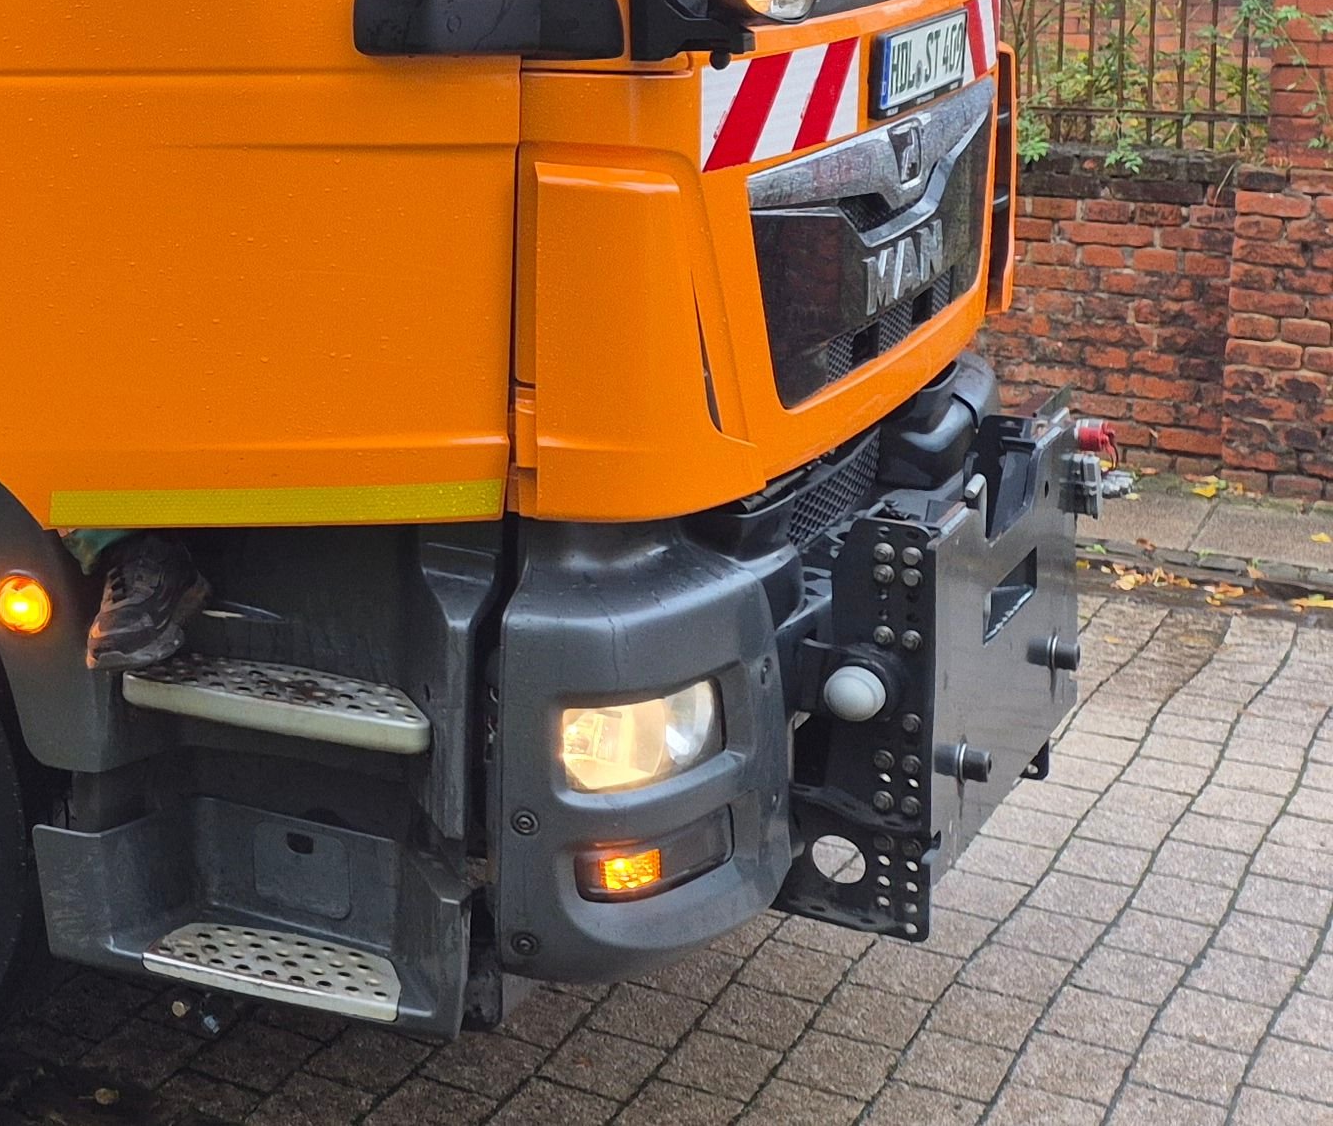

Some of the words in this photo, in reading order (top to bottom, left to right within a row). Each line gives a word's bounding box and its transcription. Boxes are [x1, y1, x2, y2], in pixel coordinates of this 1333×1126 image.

[890, 40, 916, 98] HDL
[924, 29, 942, 84] ST
[942, 21, 964, 75] 409
[861, 218, 944, 316] MAN
